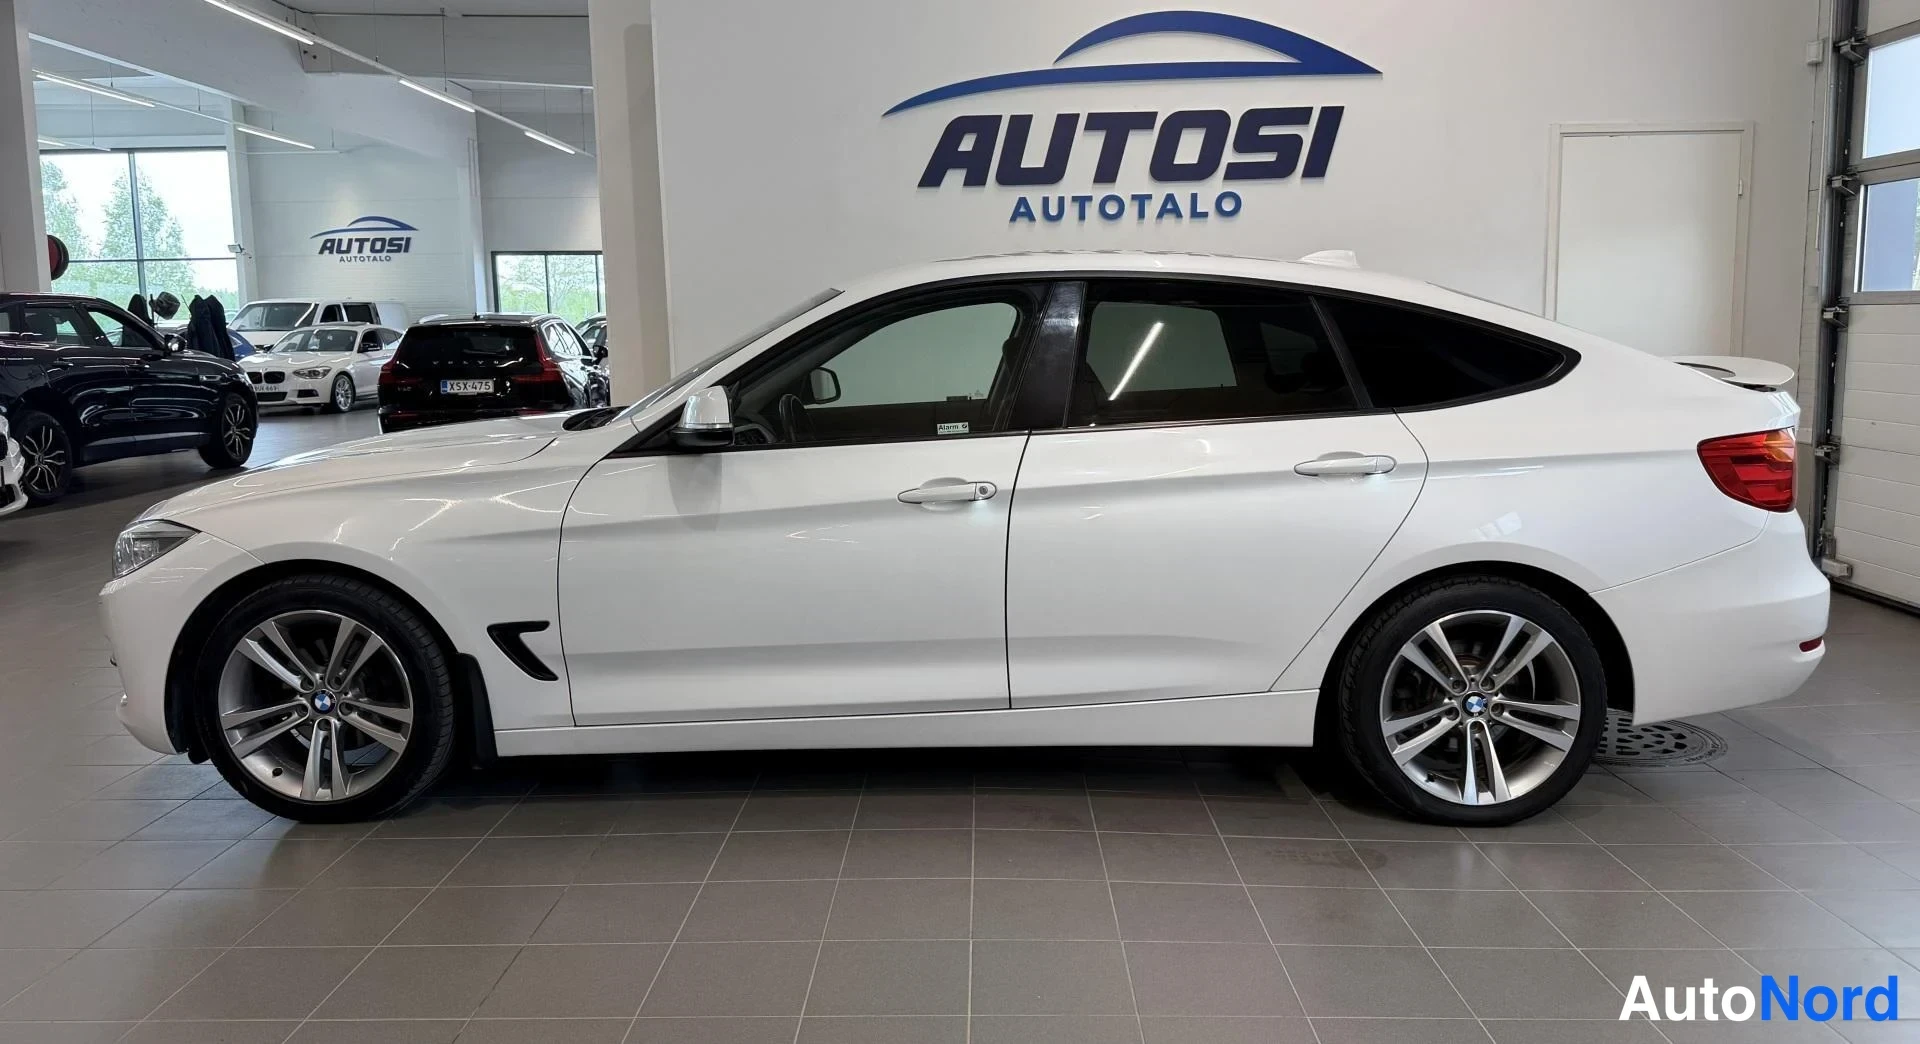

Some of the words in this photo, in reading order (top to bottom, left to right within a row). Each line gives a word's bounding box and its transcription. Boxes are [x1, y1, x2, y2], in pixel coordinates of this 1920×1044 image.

[917, 106, 1345, 188] AUTOSI
[1009, 191, 1243, 223] AUTOTALO
[318, 237, 412, 255] AUTOSI
[339, 255, 392, 263] AUTOTALO
[449, 381, 491, 391] XSX-475
